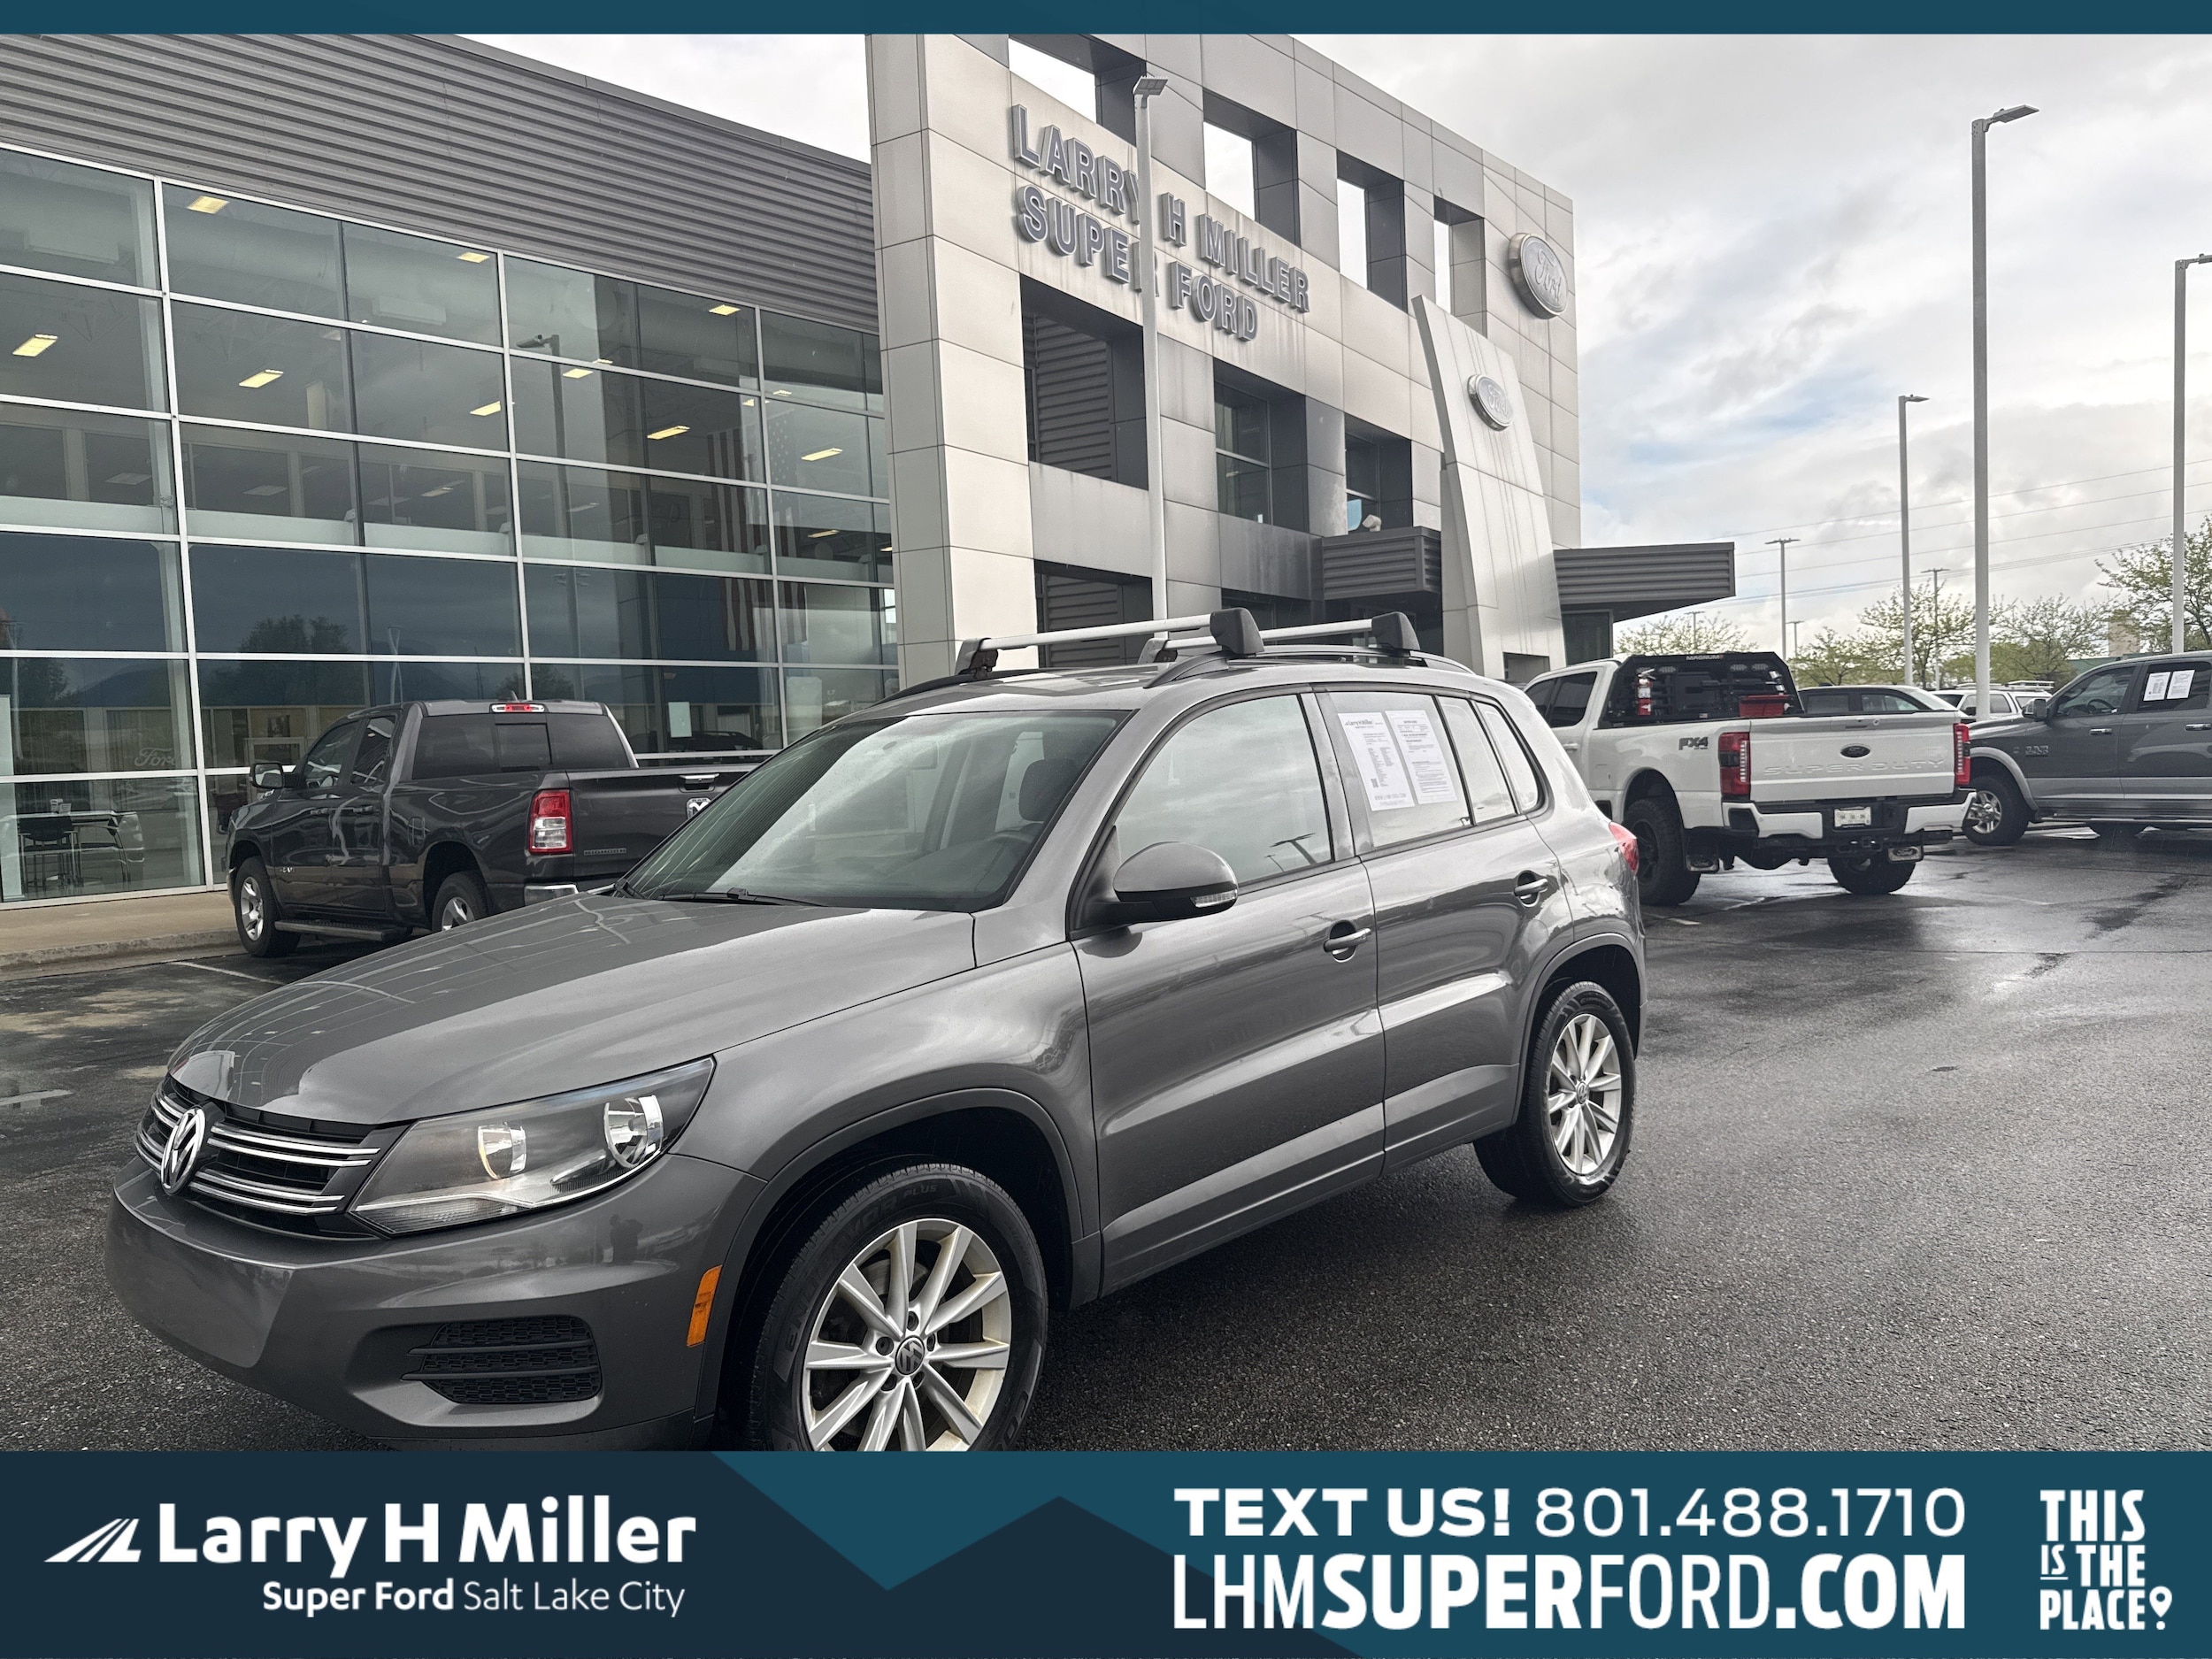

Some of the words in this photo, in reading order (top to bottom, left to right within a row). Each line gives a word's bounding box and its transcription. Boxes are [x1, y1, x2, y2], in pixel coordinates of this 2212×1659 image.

[1018, 184, 1159, 297] SUPE
[1170, 261, 1257, 342] FORD
[1161, 192, 1187, 247] H
[1198, 213, 1310, 313] MILLER
[1678, 736, 1709, 750] FX4
[1763, 763, 1863, 776] SUPER
[1871, 759, 1944, 771] DUTY
